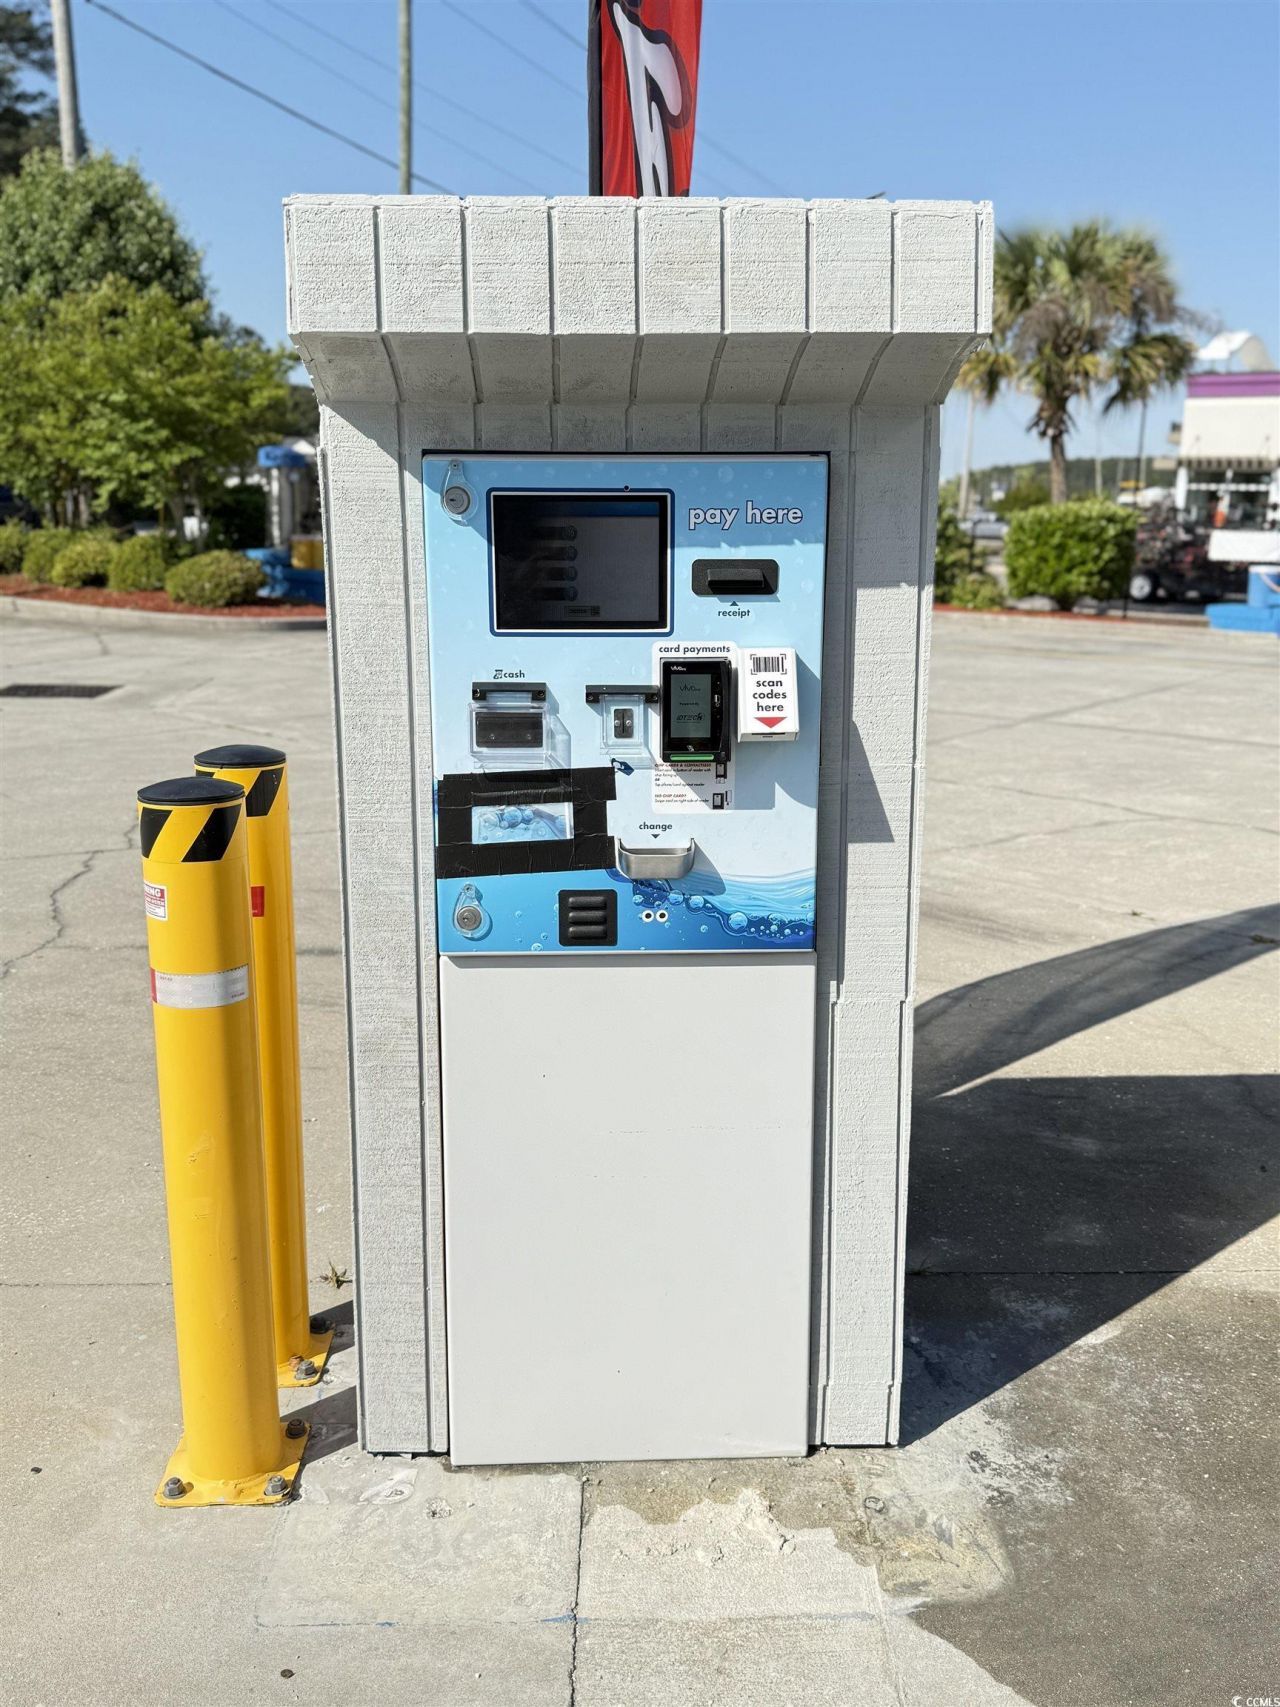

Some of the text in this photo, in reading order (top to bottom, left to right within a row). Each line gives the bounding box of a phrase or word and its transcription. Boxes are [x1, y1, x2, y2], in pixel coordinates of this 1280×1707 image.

[688, 500, 803, 531] pay here
[717, 608, 751, 619] receipt
[658, 644, 731, 655] card payments
[503, 669, 526, 679] cash
[756, 680, 783, 688] scan
[752, 689, 787, 699] codes
[757, 702, 784, 712] here
[639, 822, 673, 832] change
